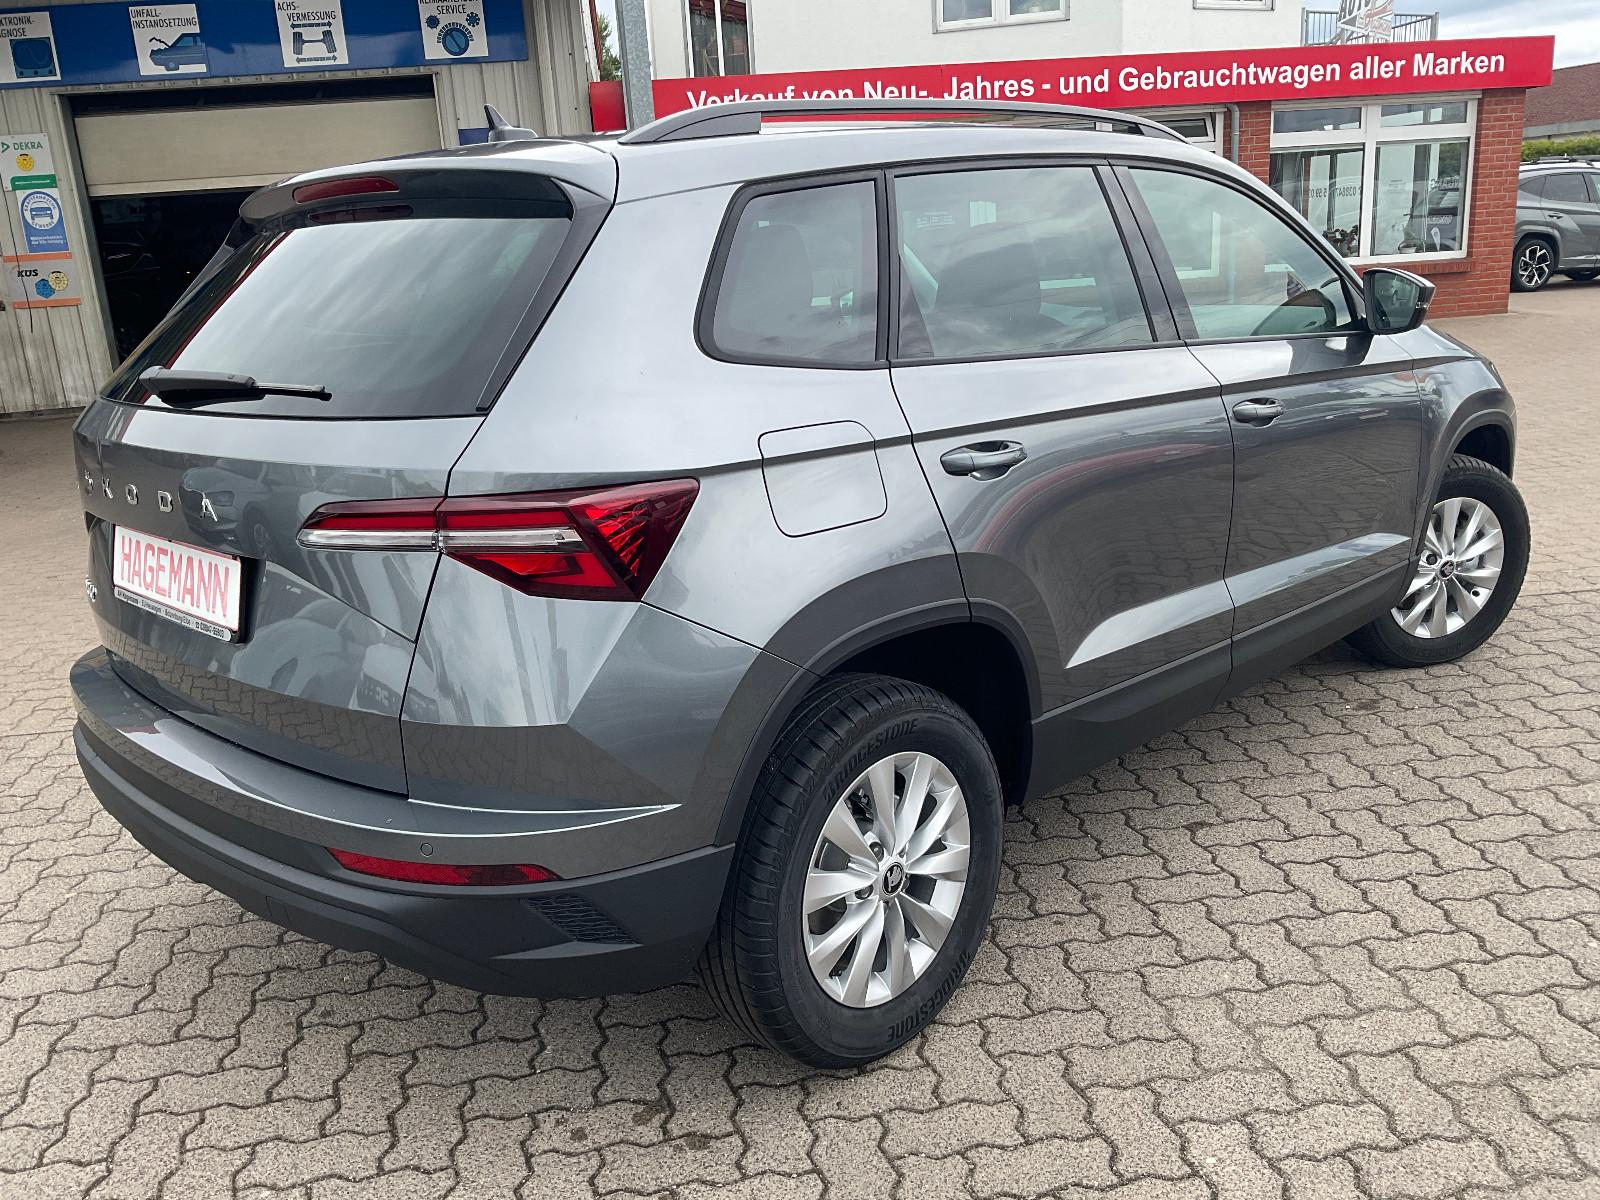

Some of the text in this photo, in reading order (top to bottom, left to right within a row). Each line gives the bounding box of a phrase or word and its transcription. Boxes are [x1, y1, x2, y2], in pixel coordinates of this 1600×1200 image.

[277, 1, 300, 11] ACHS-
[436, 4, 467, 15] SERVICE
[130, 8, 162, 19] UNFALL-
[287, 10, 337, 22] VERMESSUNG
[132, 17, 197, 29] INSTANDSETZUNG
[943, 76, 1035, 100] Jahres
[1059, 68, 1109, 95] und
[1118, 61, 1340, 92] Gebrauchtwagen
[1350, 55, 1406, 80] aller
[1412, 50, 1505, 77] Marken
[13, 140, 43, 151] DEKRA
[121, 535, 230, 617] HAGEMANN
